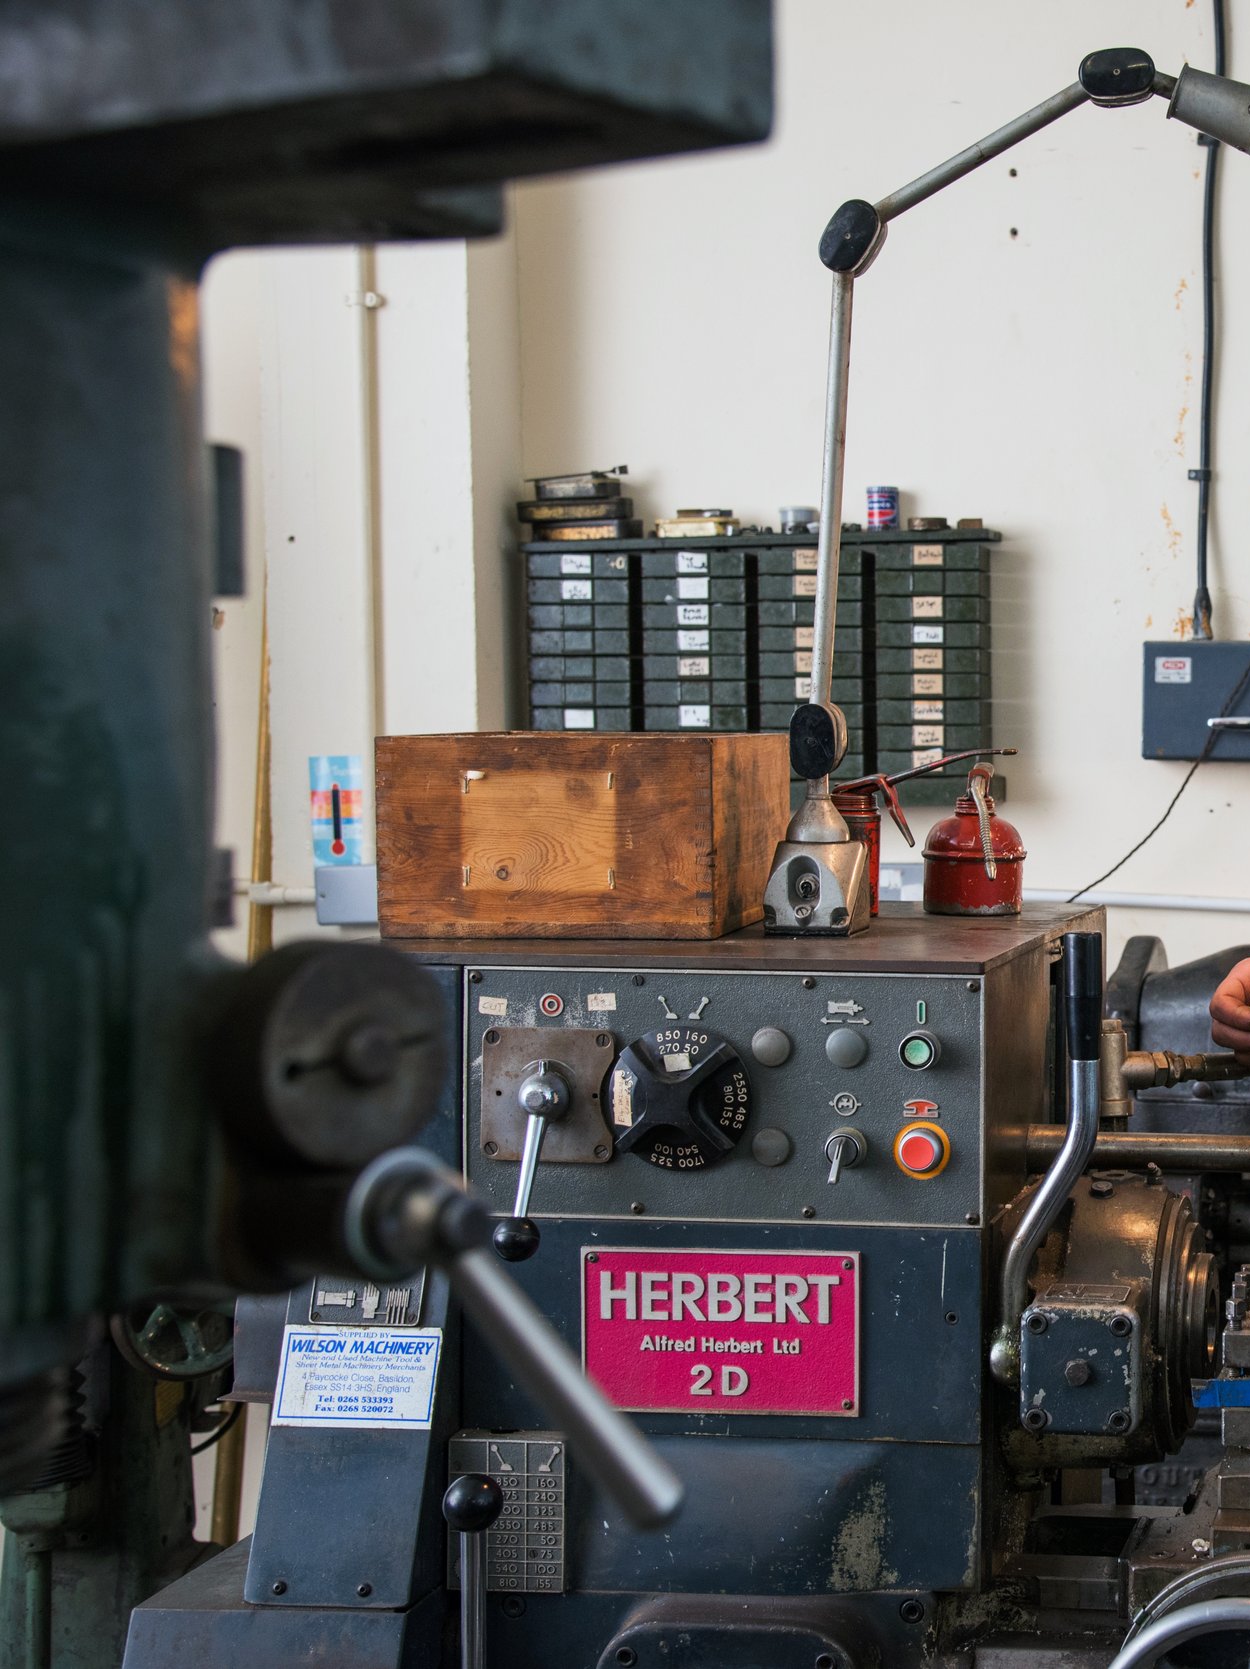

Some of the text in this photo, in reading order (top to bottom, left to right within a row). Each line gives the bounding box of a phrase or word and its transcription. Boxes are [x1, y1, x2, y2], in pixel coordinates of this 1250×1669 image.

[656, 1030, 708, 1044] 850 160
[658, 1043, 699, 1055] 270 50
[732, 1072, 748, 1129] 2550 485
[720, 1085, 734, 1127] 810 155
[654, 1143, 699, 1156] 540 100
[650, 1153, 705, 1168] 1700 325
[599, 1270, 840, 1325] HERBERT
[338, 1331, 378, 1339] SUPPLIED
[291, 1339, 434, 1355] WILSON MACHINERY
[639, 1334, 800, 1355] Alfred Herbert Ltd
[301, 1353, 318, 1361] New
[359, 1354, 394, 1362] Machine
[395, 1355, 413, 1363] Tool
[342, 1362, 383, 1371] Machinery
[384, 1363, 426, 1371] Merchants
[309, 1372, 349, 1382] Paycocke
[304, 1382, 328, 1391] Essex
[330, 1383, 352, 1392] SS14
[376, 1384, 411, 1394] England
[318, 1394, 394, 1404] Tel: 0268 533393
[314, 1404, 394, 1413] Fax: 0268 520072
[536, 1478, 556, 1488] 160
[534, 1492, 556, 1502] 240
[534, 1506, 554, 1516] 325
[493, 1521, 554, 1531] 2550 485
[496, 1534, 556, 1545] 270 50
[496, 1550, 553, 1559] 405 75
[495, 1564, 556, 1574] 540 100
[499, 1578, 551, 1588] 810 155
